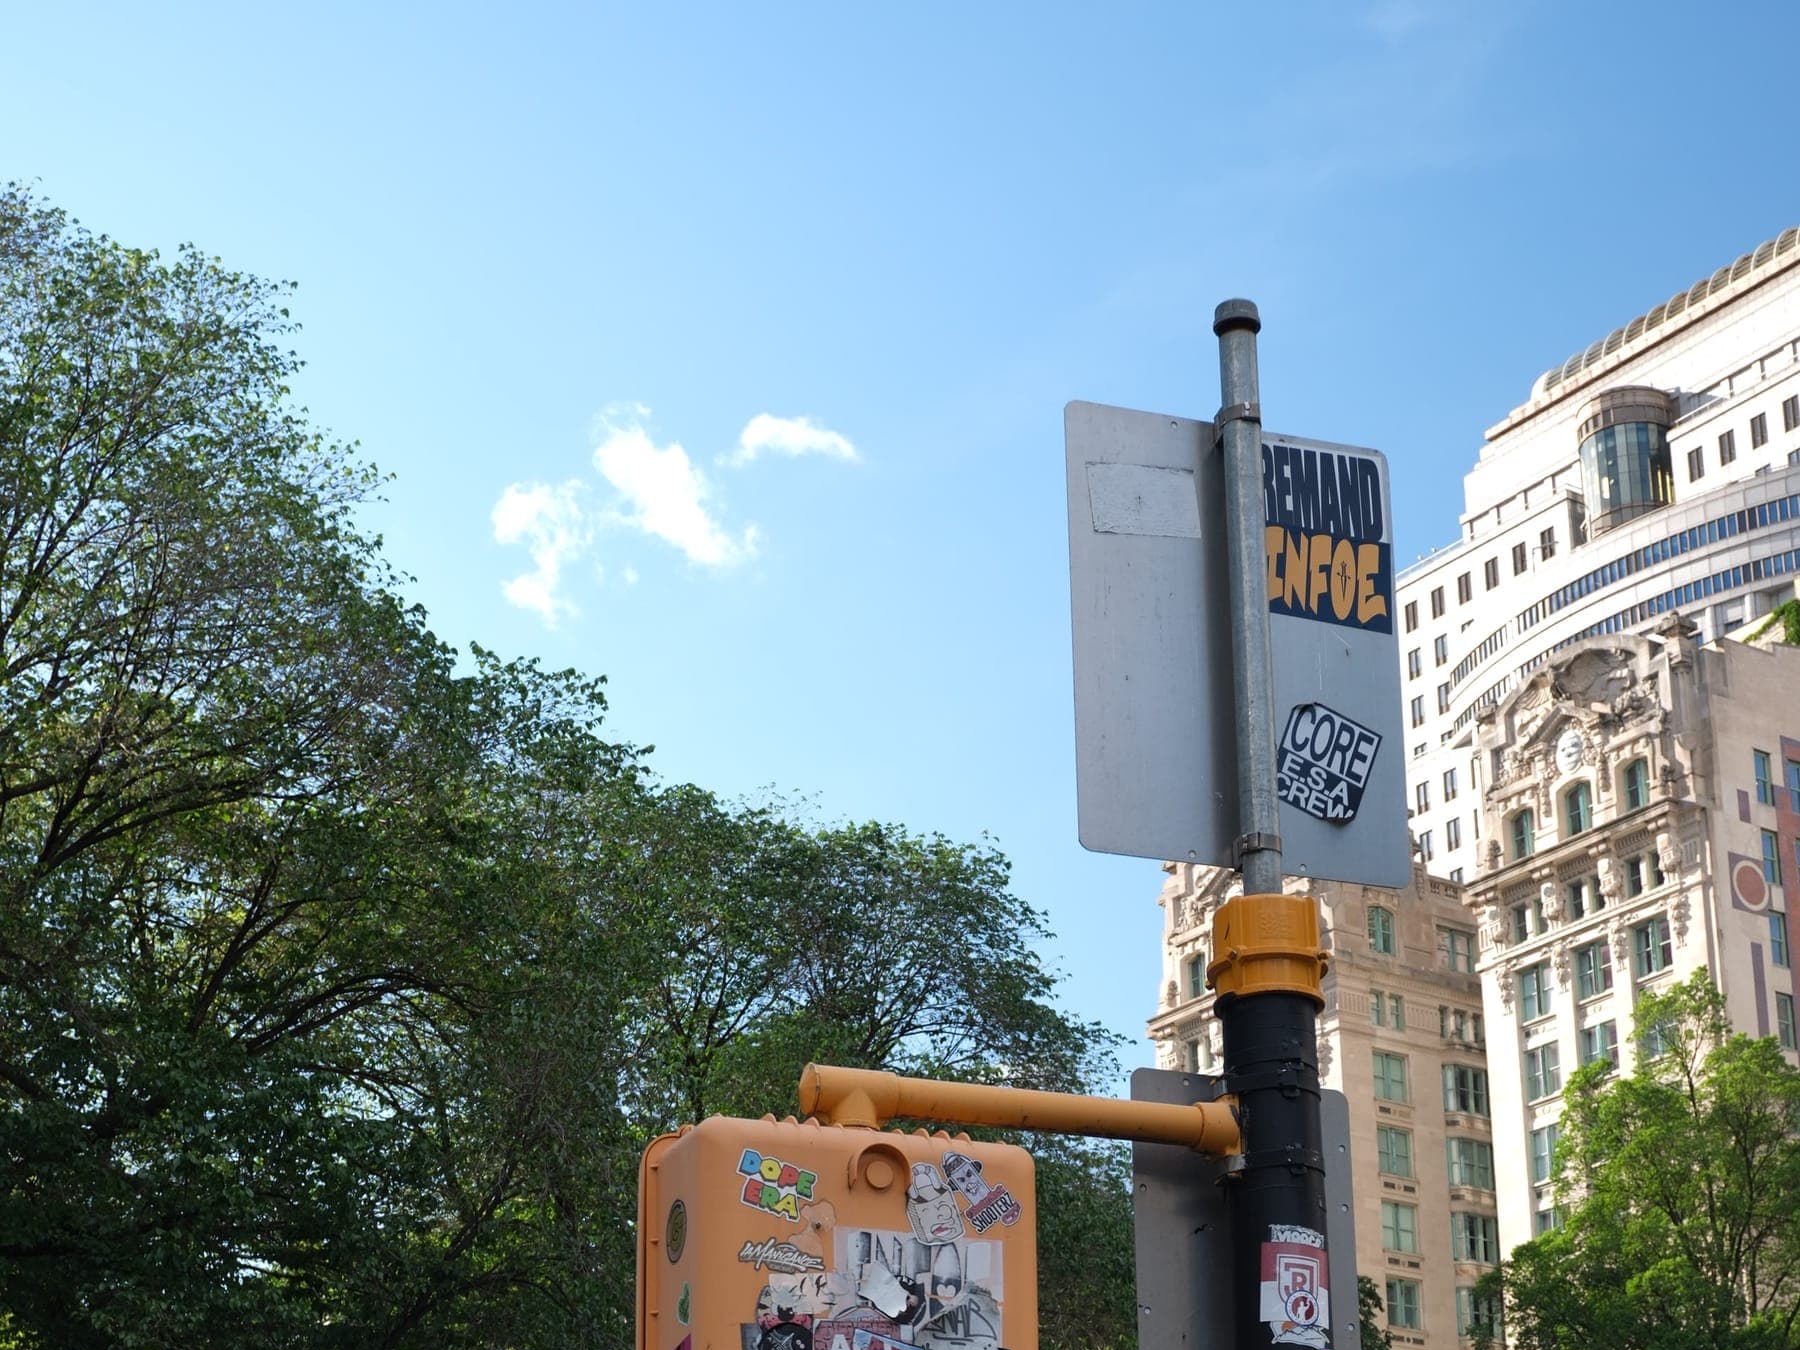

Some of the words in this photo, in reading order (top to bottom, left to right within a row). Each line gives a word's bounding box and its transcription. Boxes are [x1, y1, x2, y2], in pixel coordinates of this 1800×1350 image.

[1291, 704, 1375, 786] CORE
[1277, 773, 1354, 819] CREW
[738, 1150, 816, 1199] DOPE
[743, 1178, 799, 1220] ERA
[972, 1192, 1014, 1232] SHOOTERZ
